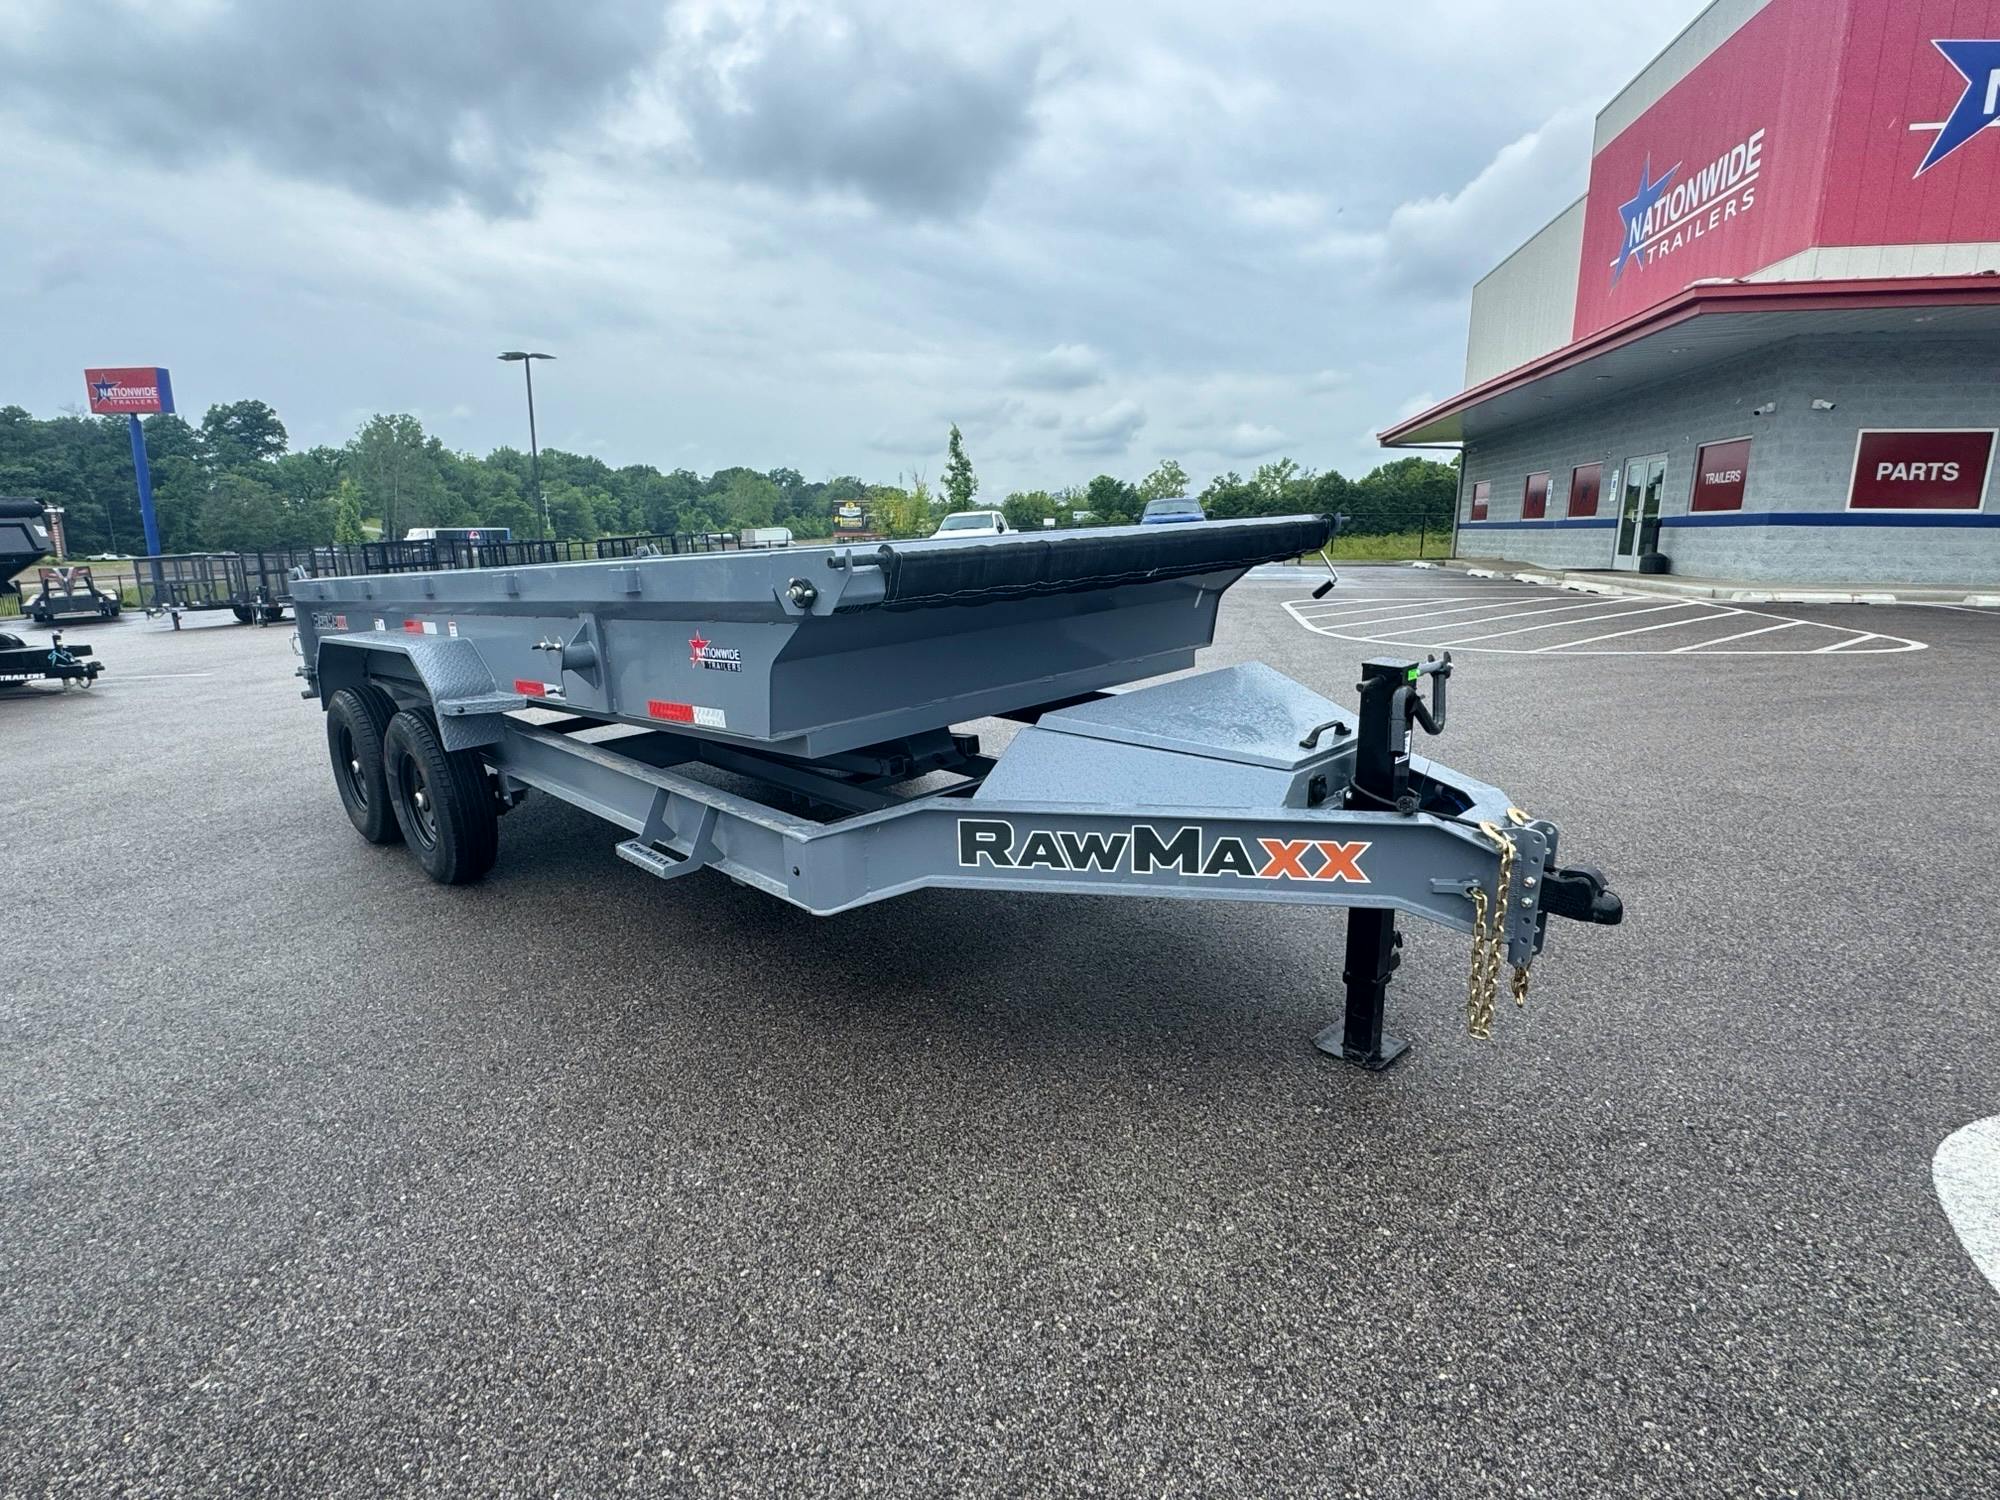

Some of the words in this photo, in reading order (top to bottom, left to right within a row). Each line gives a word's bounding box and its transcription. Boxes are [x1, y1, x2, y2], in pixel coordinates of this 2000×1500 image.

[1629, 128, 1765, 247] NATIONWIDE
[1647, 187, 1755, 265] TRAILERS
[100, 387, 158, 397] NATIONWIDE
[1705, 470, 1741, 485] TRAILERS
[1876, 462, 1959, 481] PARTS
[696, 648, 740, 660] NATIONWIDE
[708, 661, 741, 672] TRAILERS
[0, 673, 46, 681] TRAILERS
